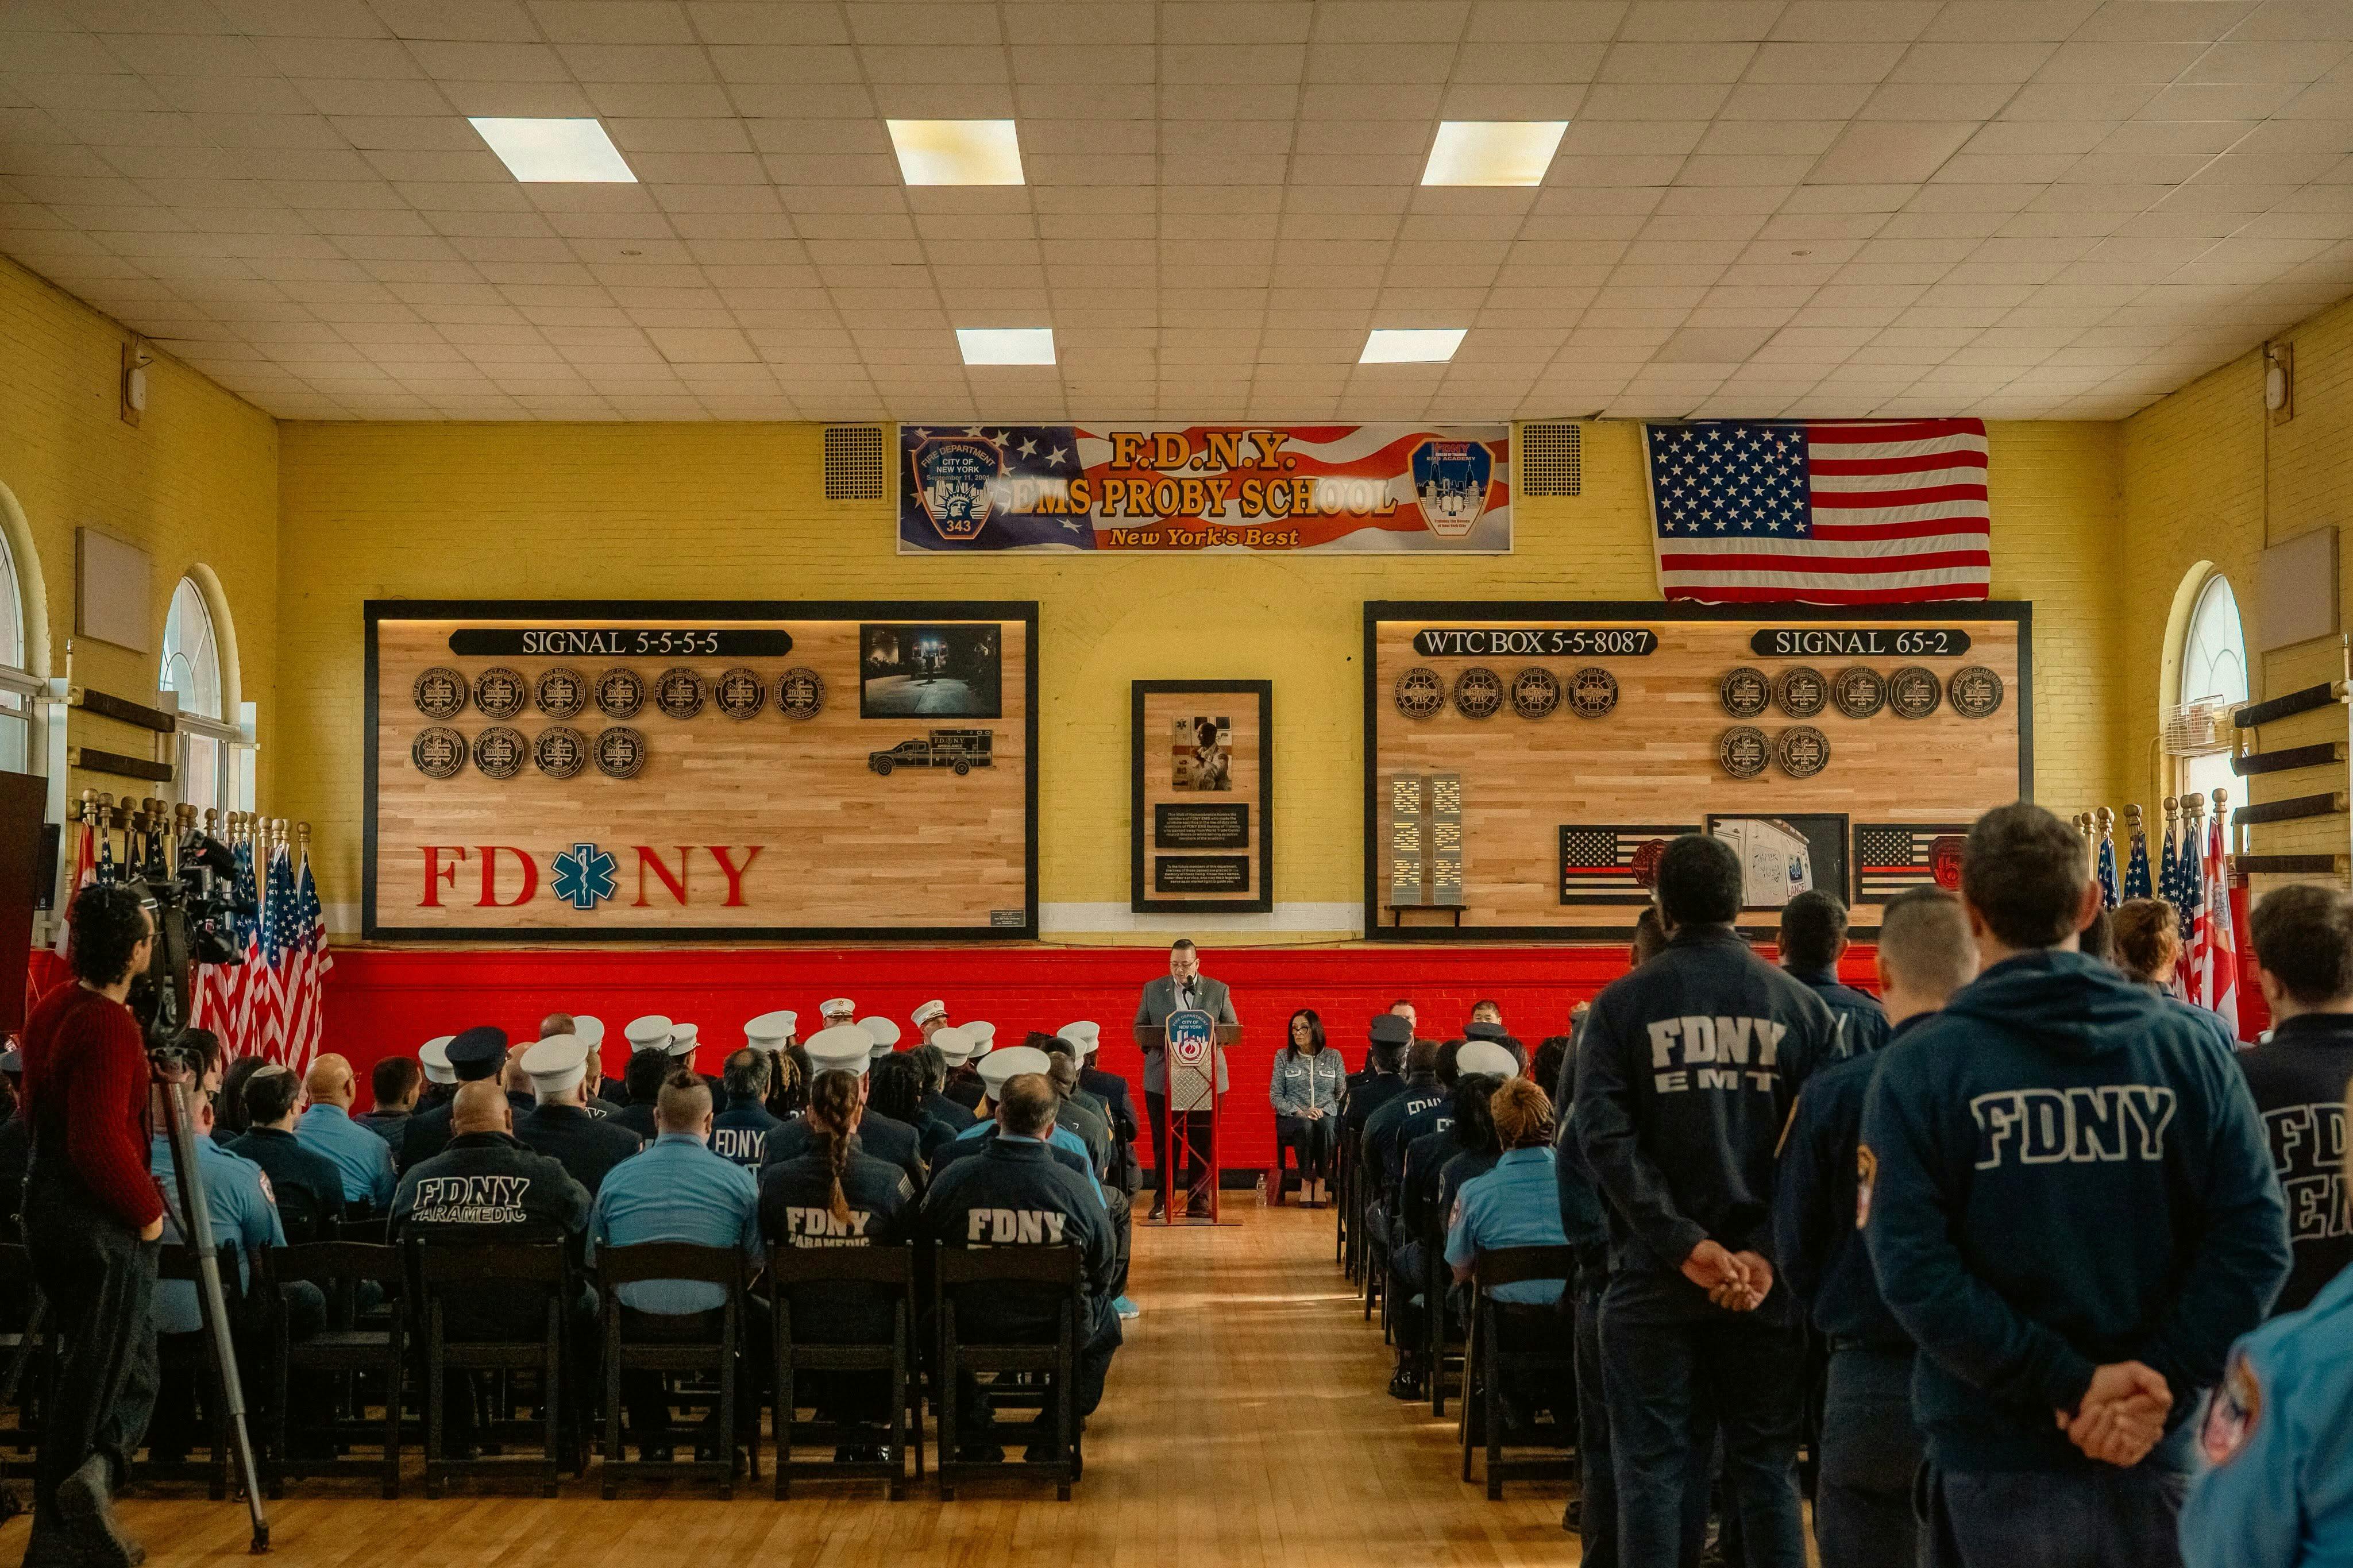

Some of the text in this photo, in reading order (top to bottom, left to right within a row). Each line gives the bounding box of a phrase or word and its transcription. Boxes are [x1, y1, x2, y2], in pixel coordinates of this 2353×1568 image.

[921, 445, 996, 468] FIRE DEPARTMENT
[1110, 432, 1297, 472] F.D.N.Y.
[1434, 444, 1470, 453] FDNY
[1010, 478, 1398, 517] EMS PROBY SCHOOL
[947, 520, 971, 532] 343
[1110, 528, 1299, 546] New York's Best
[523, 632, 718, 653] SIGNAL 5-5-5-5
[1423, 632, 1648, 654] WTC BOX 5-5-8087
[1776, 632, 1949, 654] SIGNAL 65-2
[473, 669, 497, 691] EMT TRACY
[595, 669, 645, 696] PARAMEDIC CARLOS LILLO
[675, 668, 700, 680] RICARDO
[724, 669, 744, 677] ANDRE
[1577, 668, 1596, 677] MARIA
[1603, 671, 1617, 689] RUEDA
[1958, 668, 1980, 681] THOMAS
[415, 669, 450, 687] CHRISTOPHER
[449, 672, 463, 700] PRESCOTT
[535, 669, 580, 701] LIEUTENANT BARBARA
[1436, 677, 1445, 697] BROWN
[414, 727, 461, 747] EMT YADIRA ARROYO
[473, 729, 491, 751] CAPTAIN
[511, 733, 522, 751] RUSSO
[566, 729, 583, 758] WHITESIDE
[1725, 727, 1761, 743] CHRISTOPHER
[1784, 727, 1814, 740] CHRISTINA
[1172, 1014, 1208, 1026] FIRE DEPARTMENT
[1647, 1015, 1788, 1068] FDNY
[1654, 1068, 1780, 1094] EMT
[1969, 1085, 2177, 1170] FDNY
[715, 1129, 766, 1158] FDNY
[414, 1176, 530, 1210] FDNY
[411, 1206, 527, 1223] PARAMEDIC
[786, 1207, 871, 1237] FDNY
[967, 1208, 1067, 1243] FDNY
